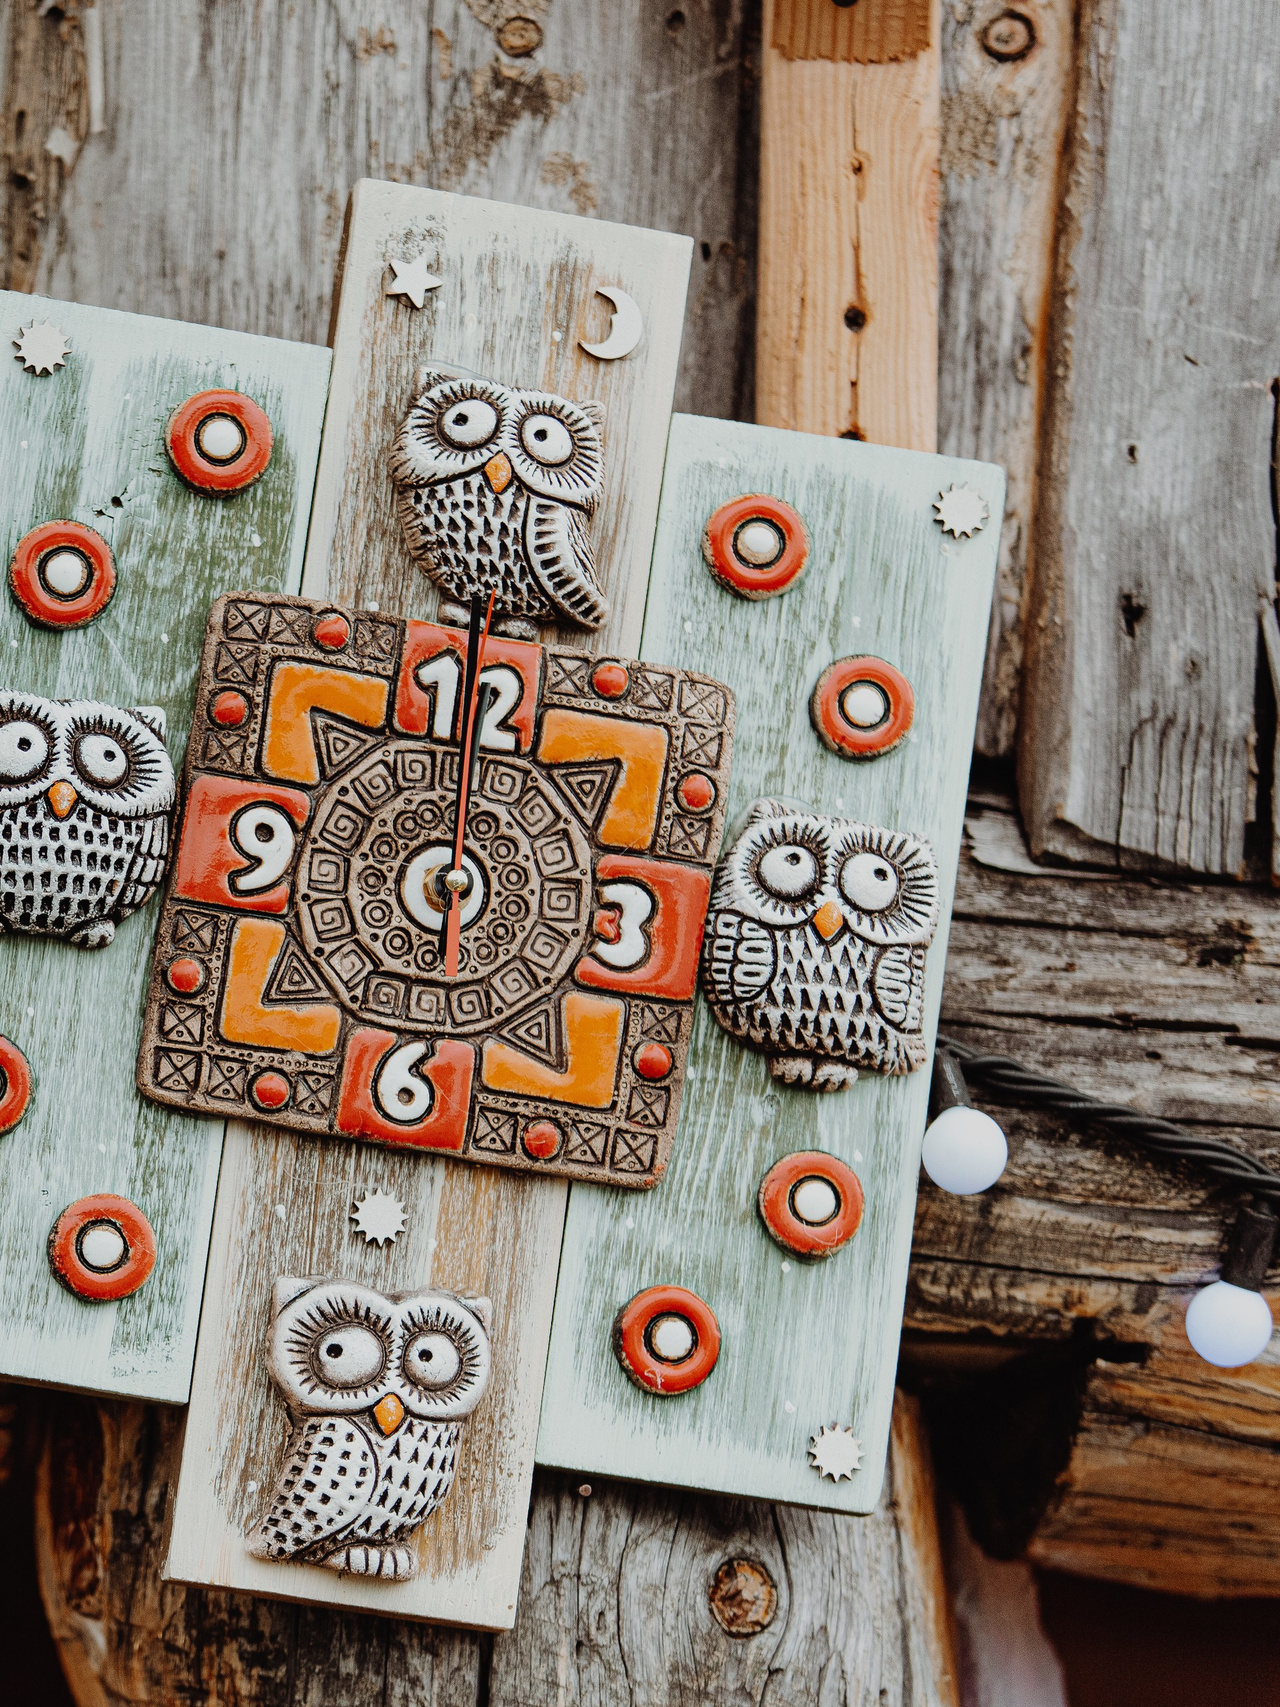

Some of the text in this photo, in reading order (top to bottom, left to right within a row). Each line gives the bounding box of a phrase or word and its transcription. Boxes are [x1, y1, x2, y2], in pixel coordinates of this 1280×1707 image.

[416, 653, 521, 752] 12
[233, 806, 295, 892] 9
[592, 883, 653, 970] 3
[378, 1042, 432, 1122] 6
